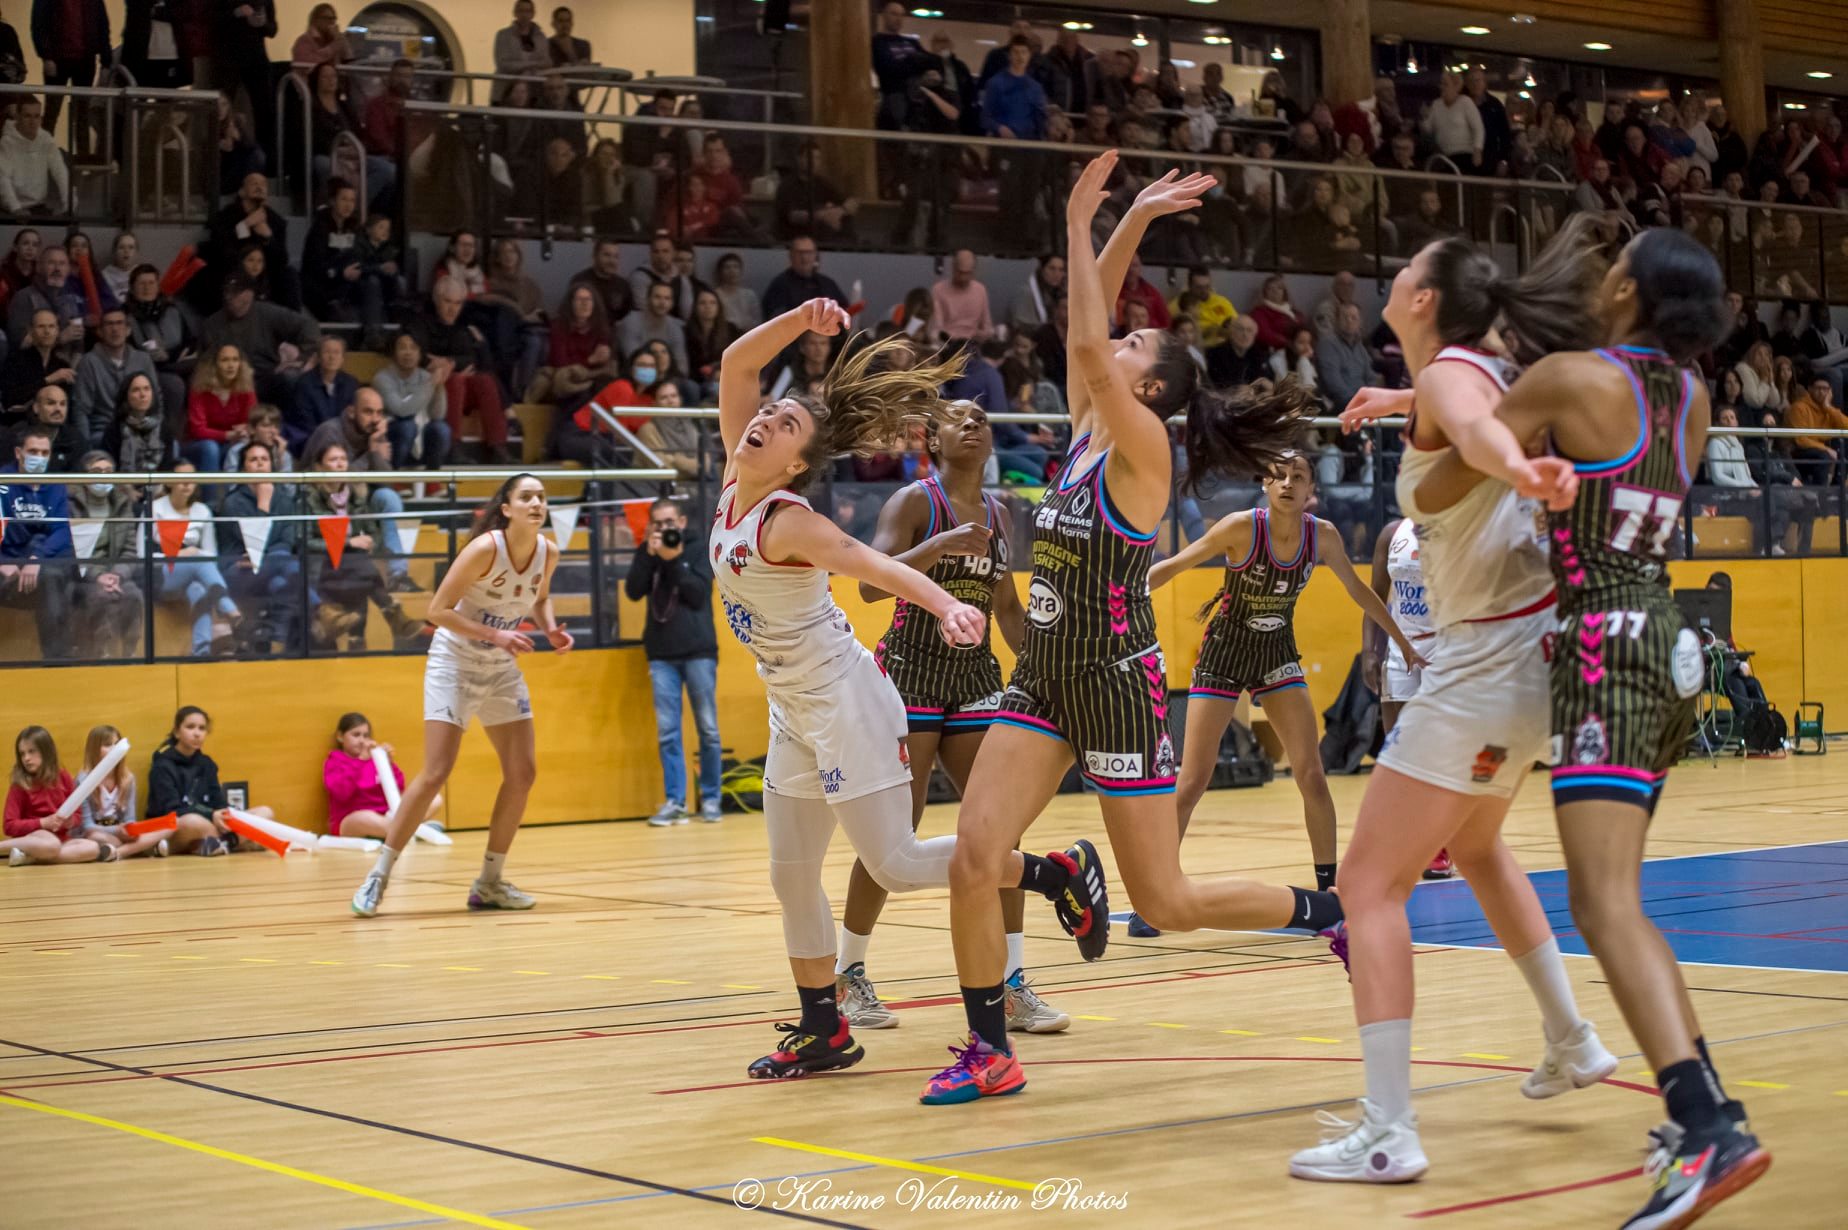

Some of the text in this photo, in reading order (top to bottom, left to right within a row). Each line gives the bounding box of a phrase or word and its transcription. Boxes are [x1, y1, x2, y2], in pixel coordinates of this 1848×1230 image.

[1035, 506, 1059, 530] 28
[1058, 513, 1094, 528] REIMS
[1610, 486, 1683, 557] 77
[964, 555, 993, 576] 40
[491, 569, 508, 588] 6
[1273, 580, 1289, 594] 3
[1394, 581, 1426, 601] Wor
[1030, 592, 1057, 614] ora
[1605, 610, 1648, 640] 77
[979, 695, 999, 706] JO
[1103, 757, 1139, 773] JOA
